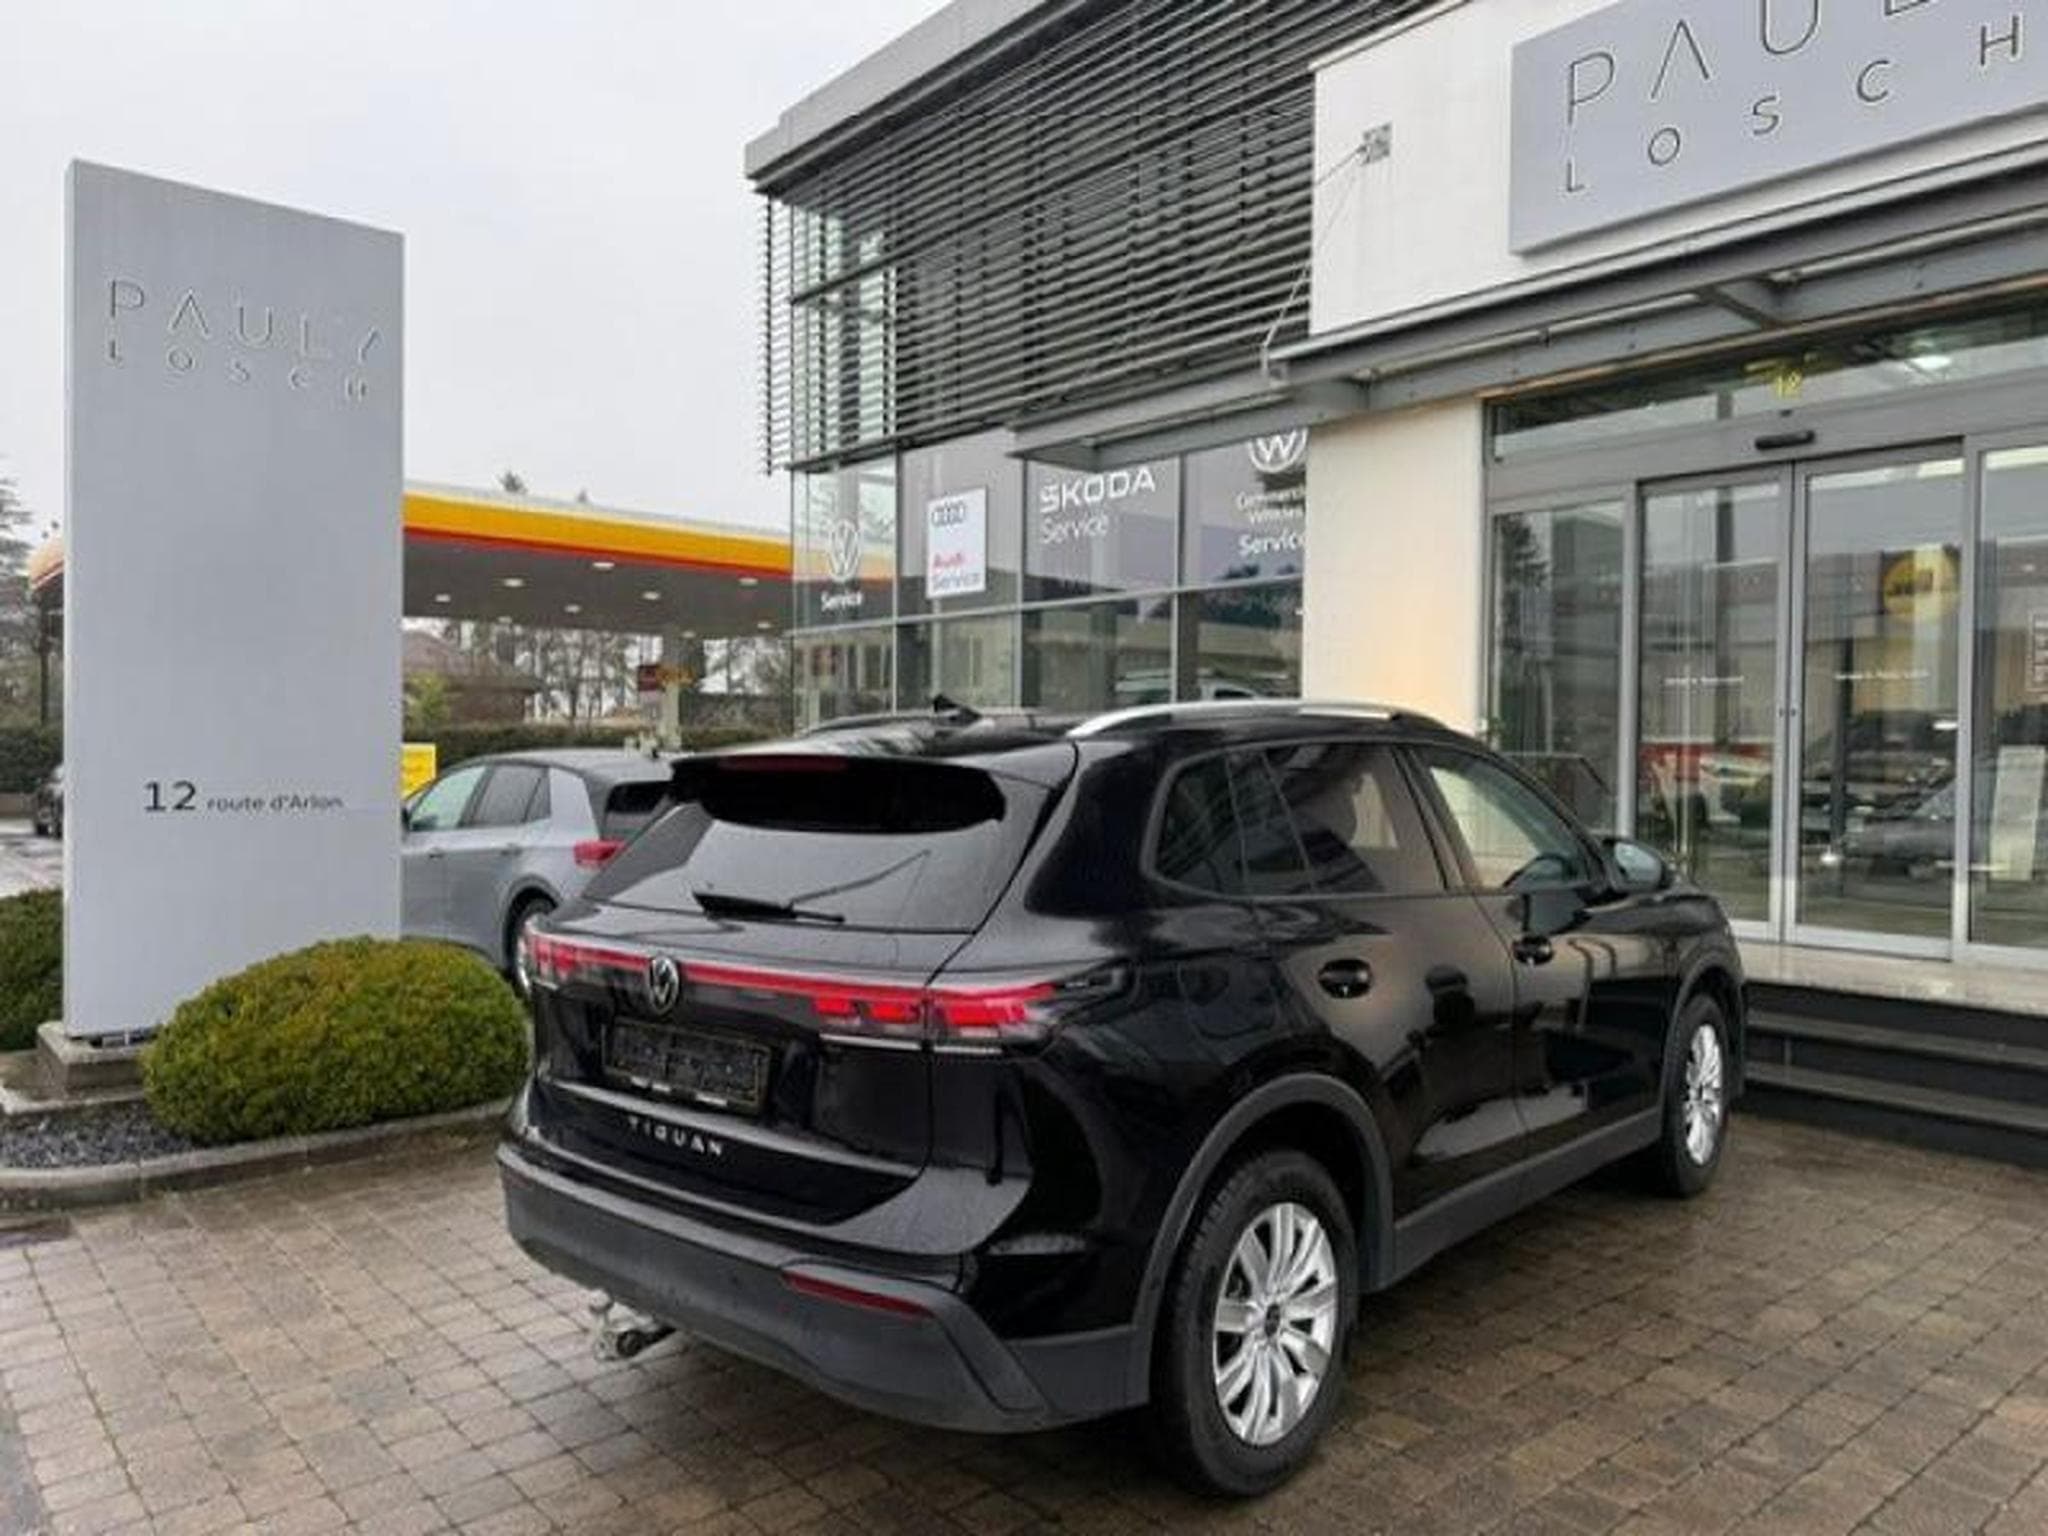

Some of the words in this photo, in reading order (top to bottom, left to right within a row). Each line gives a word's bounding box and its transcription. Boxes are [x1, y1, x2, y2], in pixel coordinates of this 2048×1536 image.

[1565, 15, 2020, 194] LOSCH
[111, 278, 379, 362] PAULY
[1040, 466, 1156, 514] ŠKODA
[1041, 515, 1108, 544] Service
[144, 780, 198, 813] 12
[206, 795, 266, 813] route
[627, 1114, 723, 1157] TIGUAN
